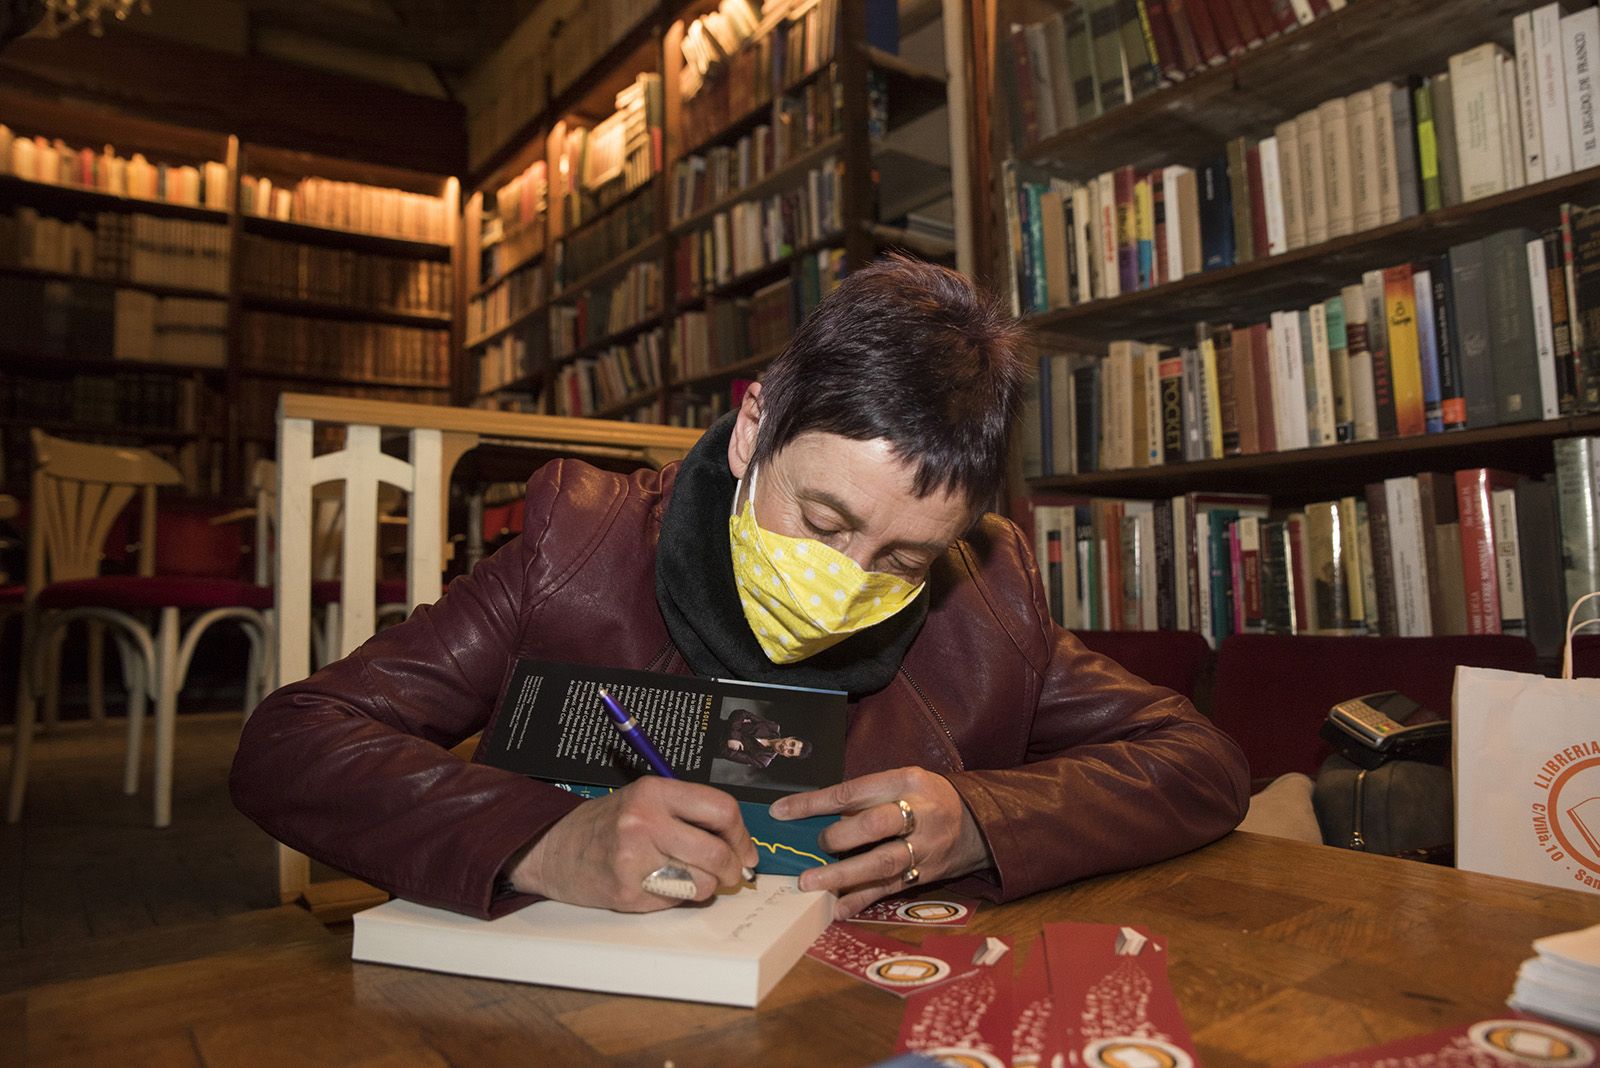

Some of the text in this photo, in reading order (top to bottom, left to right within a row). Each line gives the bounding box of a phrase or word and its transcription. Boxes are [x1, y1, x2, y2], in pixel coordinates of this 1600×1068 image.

[1578, 76, 1592, 91] DE
[1579, 93, 1595, 136] LEGADO
[1584, 137, 1597, 151] EL
[1163, 376, 1182, 443] POCKET
[704, 694, 712, 709] TURA
[700, 711, 709, 730] SOLER
[1534, 740, 1600, 790] LLIBRERIA
[1545, 843, 1565, 863] 10
